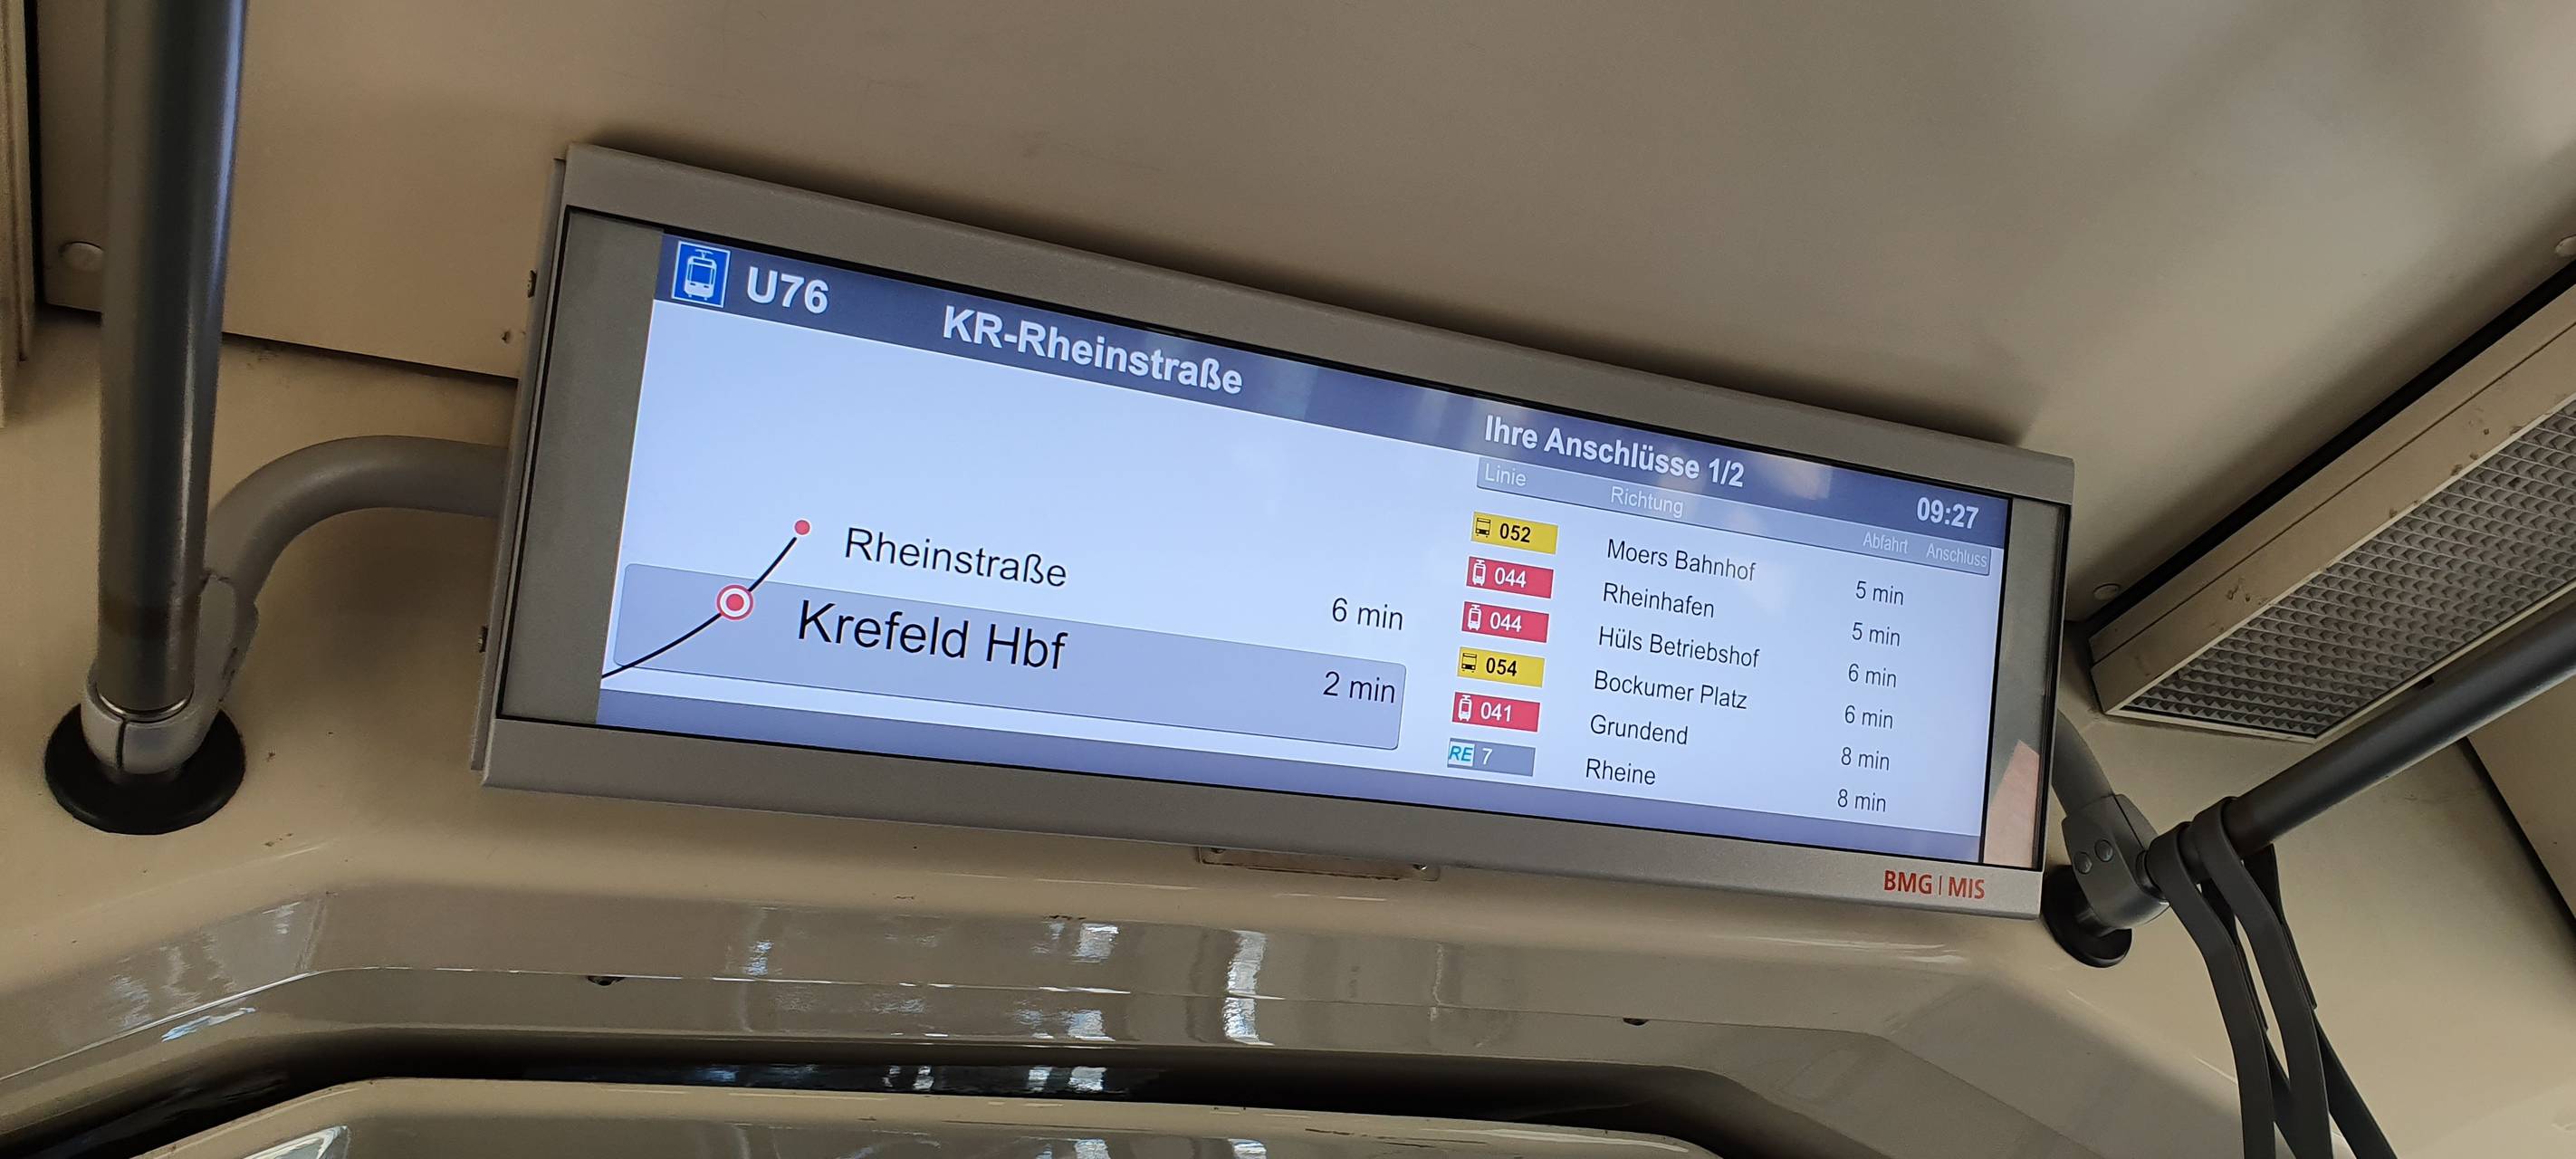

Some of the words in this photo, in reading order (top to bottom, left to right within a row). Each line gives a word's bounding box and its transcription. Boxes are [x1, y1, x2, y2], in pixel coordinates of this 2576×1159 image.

[746, 266, 829, 314] U76
[943, 305, 1243, 395] KR-Rheinstraße
[1485, 416, 1538, 451] Ihre
[1544, 427, 1700, 481] Anschlüsse
[1709, 458, 1744, 488] 1/2
[1484, 463, 1527, 487] Linie
[1611, 486, 1684, 518] Richtung
[1917, 498, 1979, 530] 09:27
[1499, 522, 1531, 543] 052
[1863, 532, 1909, 554] Abfahrt
[845, 527, 1067, 588] Rheinstraße
[1607, 539, 1668, 568] Moers
[1675, 549, 1756, 582] Bahnhof
[1926, 544, 1987, 569] Anschluss
[1494, 567, 1527, 589] 044
[1603, 583, 1715, 618] Rheinhafen
[1855, 581, 1866, 601] 5
[1872, 586, 1904, 606] min
[1331, 597, 1349, 624] 6
[1357, 604, 1404, 631] min
[1489, 612, 1522, 633] 044
[798, 600, 969, 660] Krefeld
[986, 622, 1068, 670] Hbf
[1599, 626, 1642, 652] Hüls
[1650, 633, 1760, 668] Betriebshof
[1853, 623, 1863, 642] 5
[1869, 627, 1901, 647] min
[1485, 656, 1518, 677] 054
[1847, 664, 1859, 684] 6
[1865, 667, 1898, 689] min
[1323, 671, 1339, 697] 2
[1348, 676, 1395, 703] min
[1594, 670, 1694, 704] Bockumer
[1700, 684, 1748, 710] Platz
[1480, 702, 1513, 723] 041
[1844, 705, 1855, 724] 6
[1861, 710, 1894, 730] min
[1590, 714, 1689, 746] Grundend
[1448, 744, 1474, 763] RE
[1481, 748, 1492, 766] 7
[1841, 747, 1853, 767] 8
[1858, 751, 1891, 771] min
[1585, 759, 1656, 787] Rheine
[1837, 789, 1848, 809] 8
[1854, 792, 1886, 813] min
[1884, 869, 1933, 896] BMG
[1948, 876, 1986, 900] MIS
